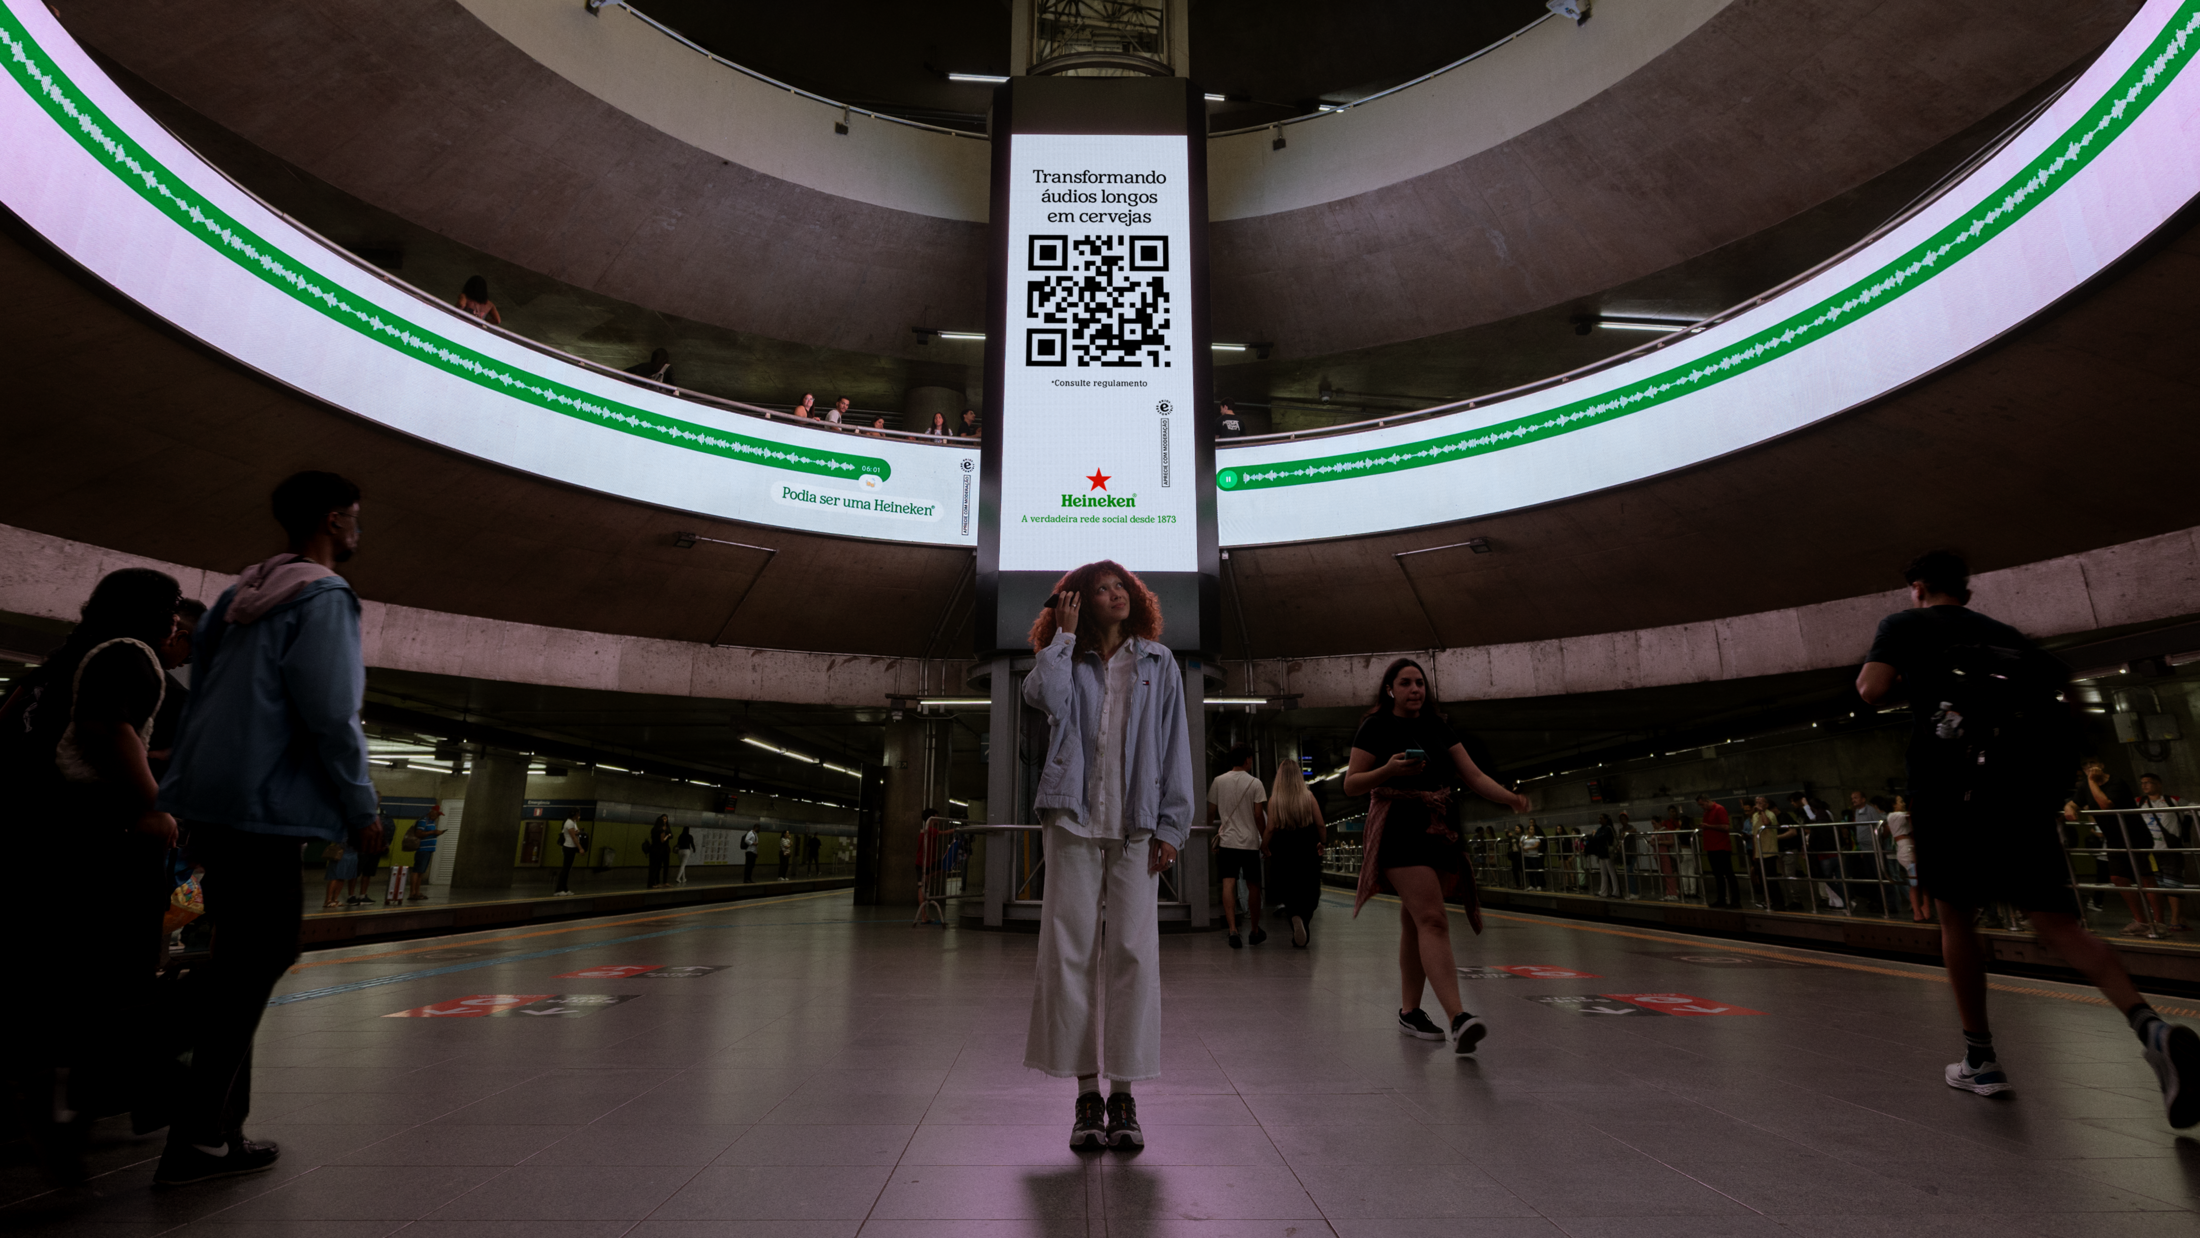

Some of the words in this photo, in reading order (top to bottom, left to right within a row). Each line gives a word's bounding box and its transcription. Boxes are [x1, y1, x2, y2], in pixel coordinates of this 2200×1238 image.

[1033, 169, 1167, 185] Transformando
[1041, 189, 1097, 204] áudios
[1101, 189, 1158, 207] longos
[1047, 211, 1076, 223] em
[1079, 209, 1152, 227] cervejas
[1093, 379, 1148, 389] regulamento
[782, 486, 817, 504] Podia
[819, 494, 841, 507] ser
[843, 497, 871, 511] uma
[1021, 514, 1028, 523] A
[1030, 514, 1078, 524] verdadeira
[1080, 514, 1100, 524] rede
[1102, 514, 1128, 524] social
[1130, 514, 1155, 524] desde
[1157, 514, 1177, 524] 1873
